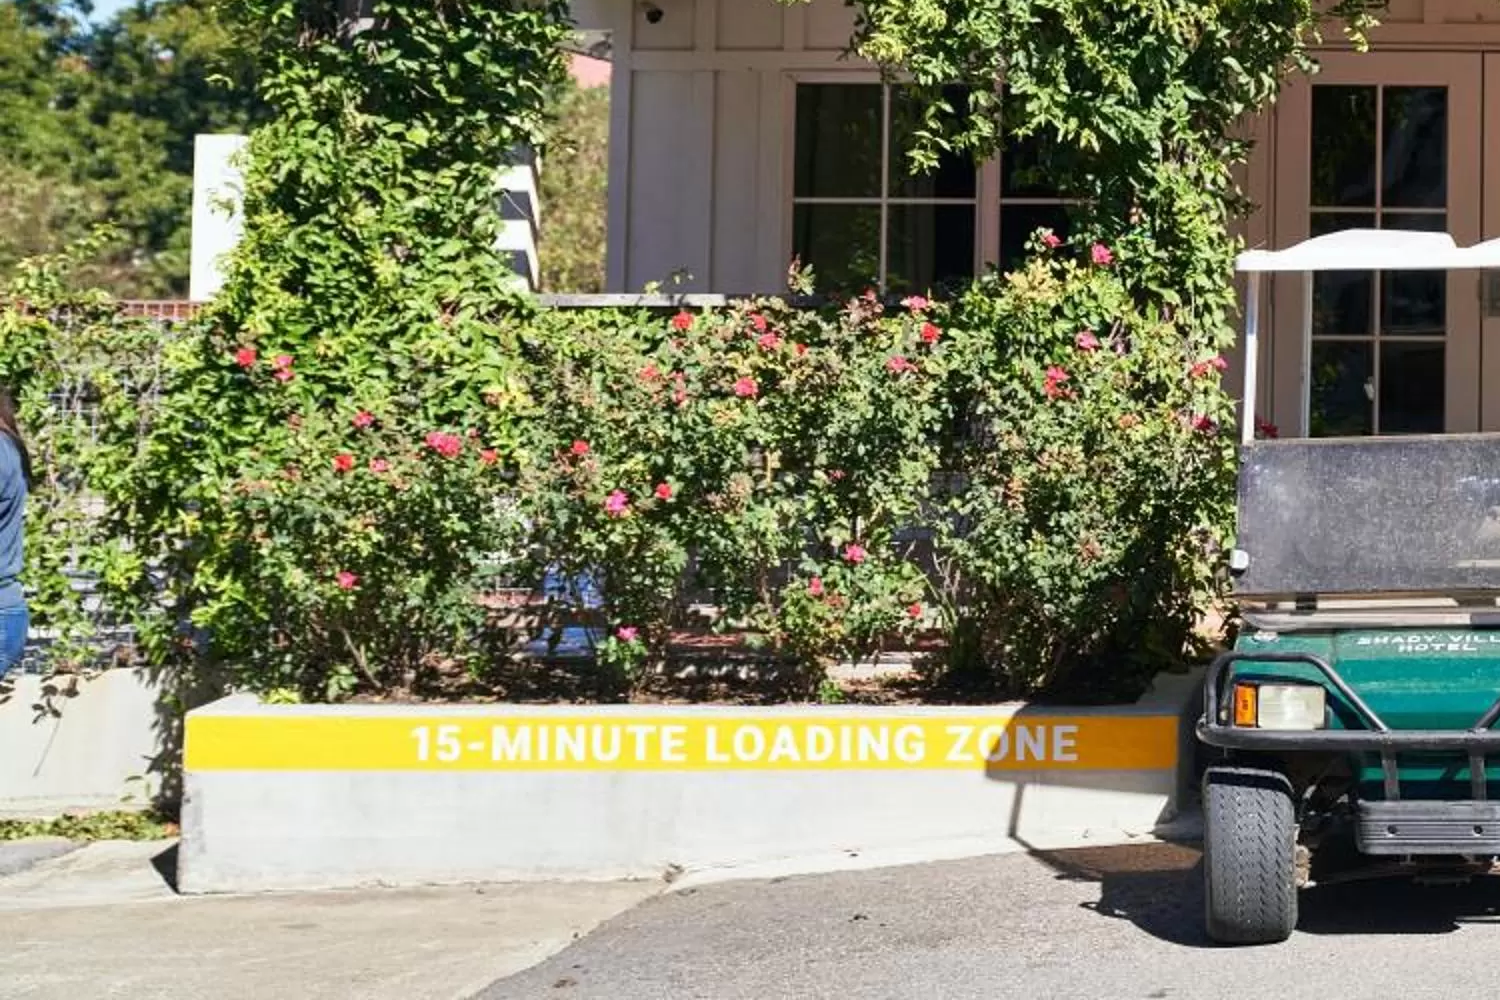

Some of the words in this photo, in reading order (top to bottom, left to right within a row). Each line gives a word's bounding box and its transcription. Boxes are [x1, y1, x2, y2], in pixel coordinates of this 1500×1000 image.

[1356, 635, 1438, 645] SHADY
[1398, 643, 1477, 652] HOTEL
[411, 725, 687, 762] 15-MINUTE
[704, 725, 926, 762] LOADING
[946, 725, 1080, 762] ZONE
